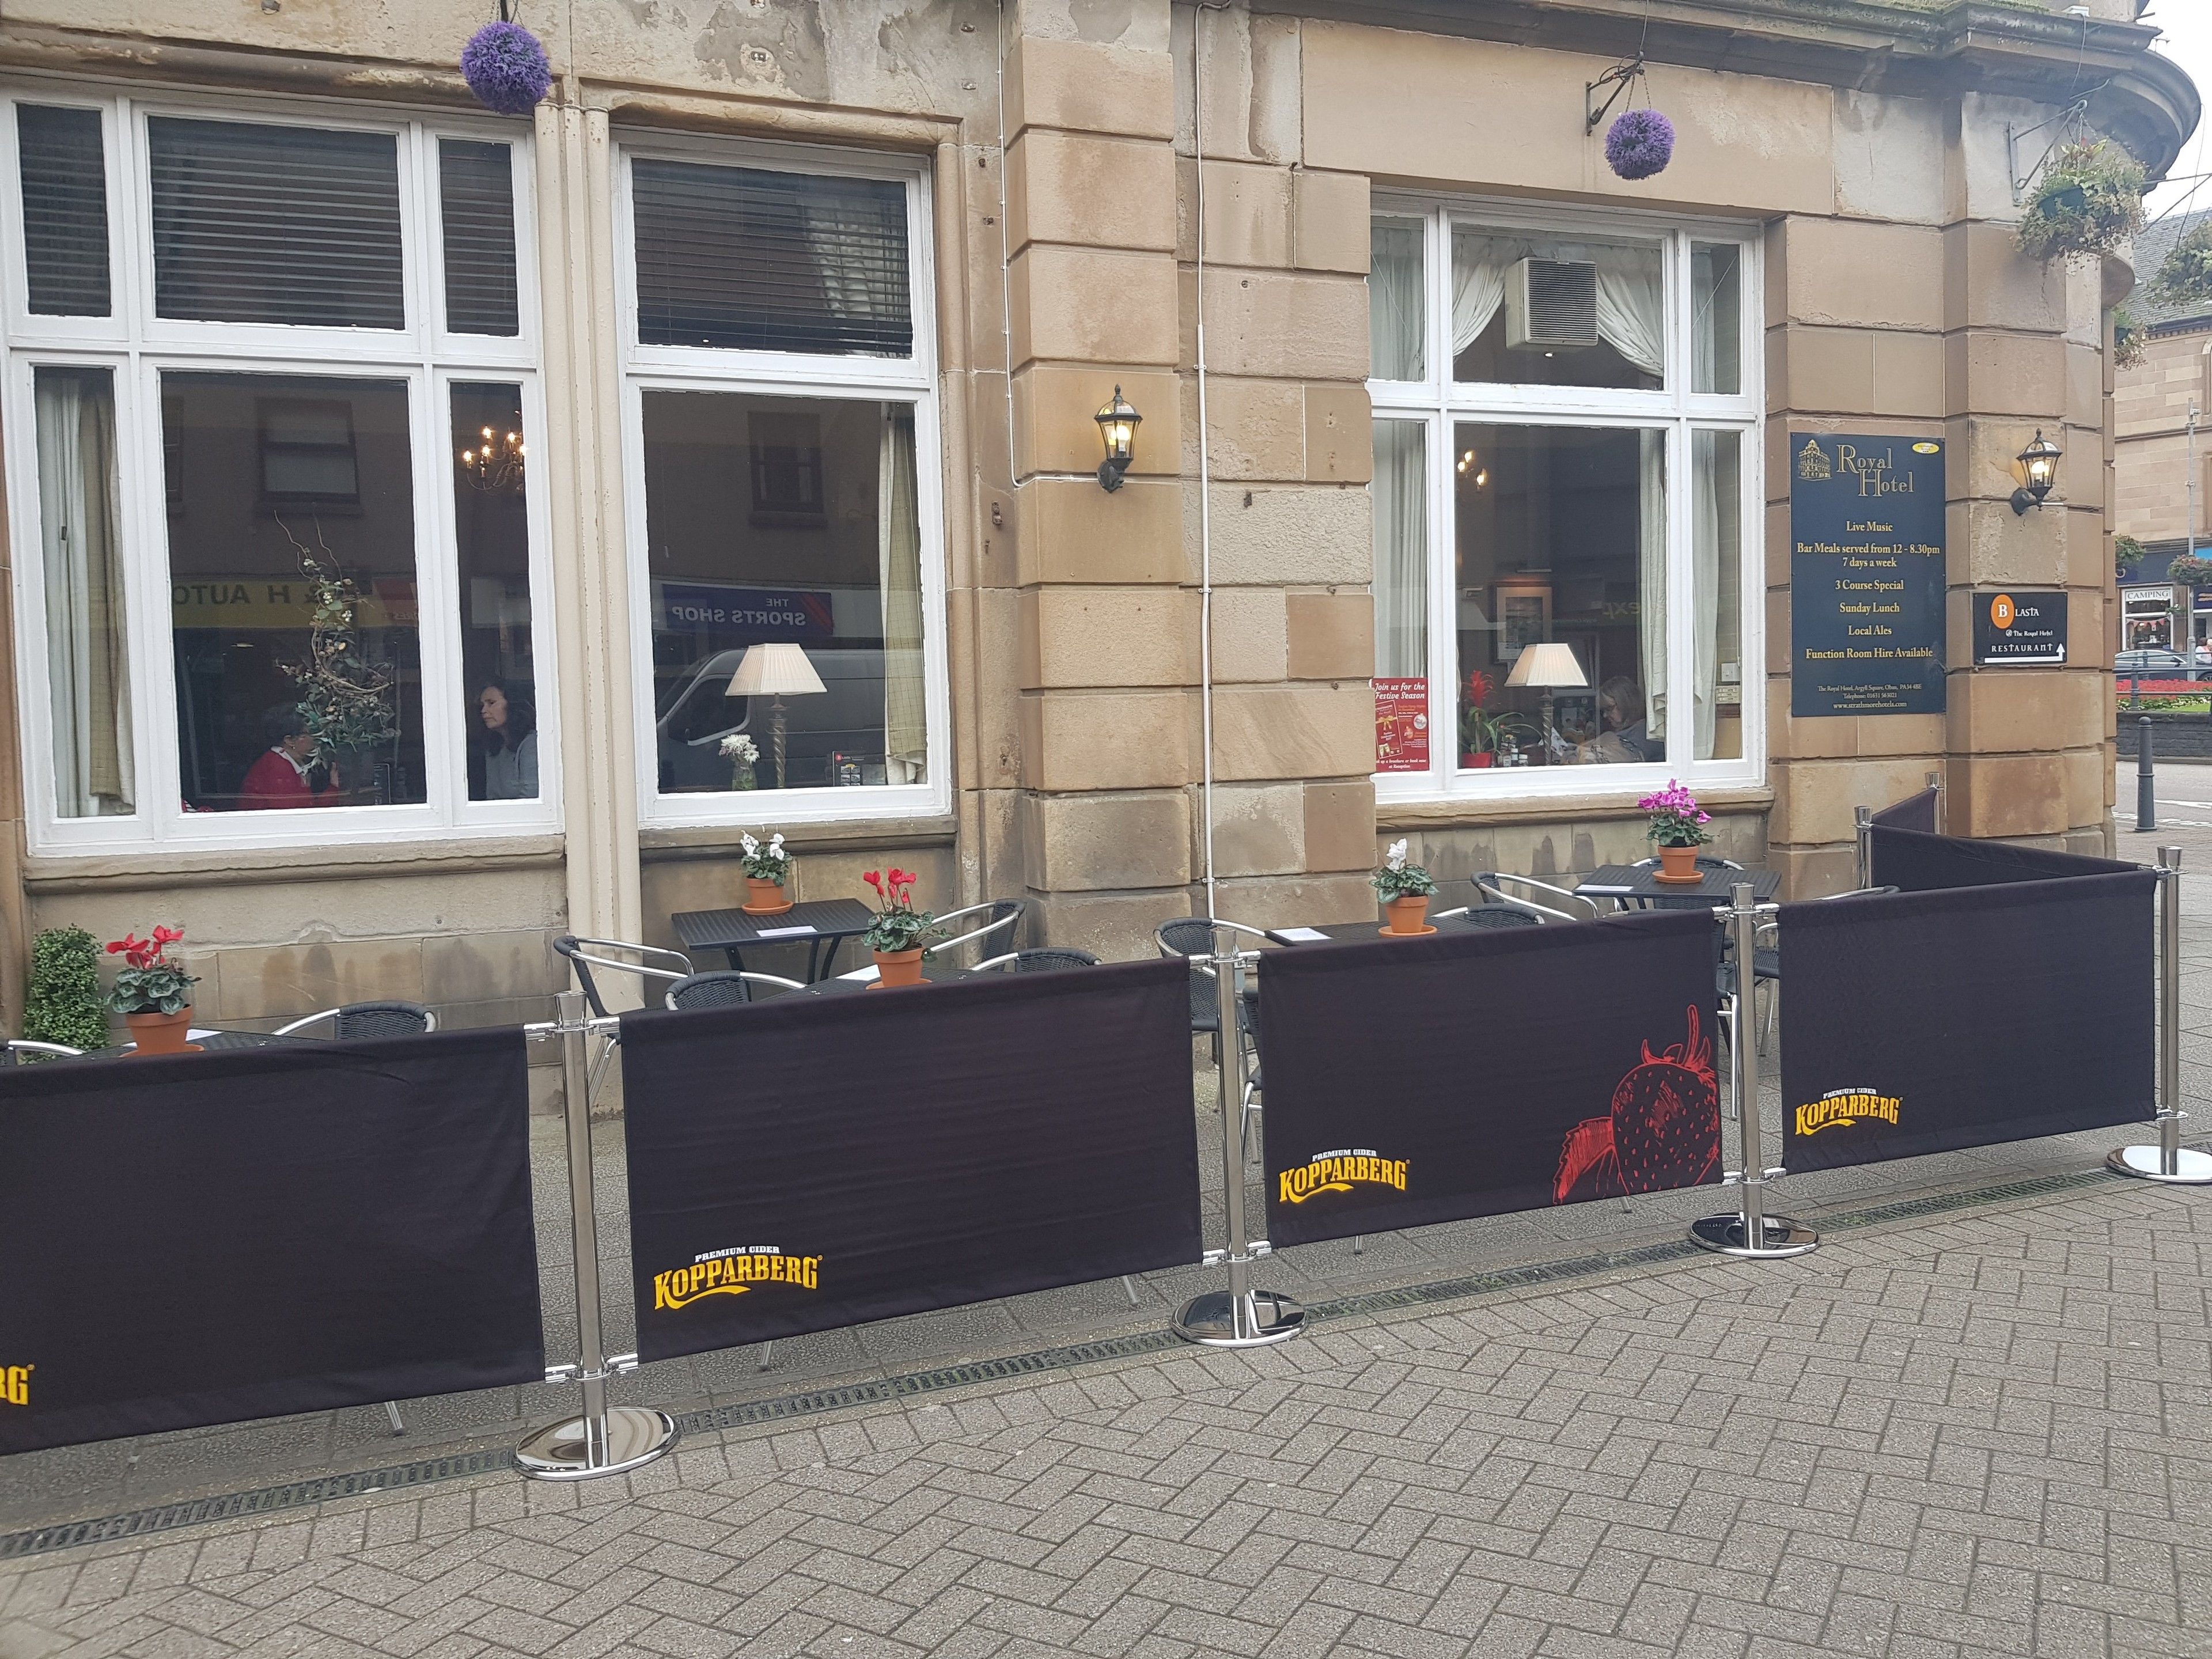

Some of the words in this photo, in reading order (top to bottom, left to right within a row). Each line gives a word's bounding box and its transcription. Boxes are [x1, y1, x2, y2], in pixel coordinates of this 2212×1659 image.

[1836, 444, 1893, 474] Royal
[1858, 468, 1914, 497] Hotel
[1846, 521, 1865, 532] Live
[1867, 521, 1893, 532] Music
[1797, 543, 1813, 553] Bar
[1814, 543, 1840, 553] Meals
[1842, 544, 1869, 554] served
[1870, 544, 1891, 554] from
[1893, 544, 1903, 554] 12
[1910, 544, 1940, 557] 8.30pm
[1842, 557, 1848, 567] 7
[1849, 557, 1868, 570] days
[1876, 558, 1897, 567] week
[1835, 580, 1841, 590] 3
[1842, 579, 1873, 590] Course
[1874, 579, 1904, 593] Special
[2127, 590, 2168, 599] CAMPING
[1839, 602, 1871, 615] Sunday
[1873, 602, 1900, 612] Lunch
[1848, 625, 1872, 635] Local
[1873, 625, 1892, 635] Ales
[1805, 649, 1844, 658] Function
[1846, 648, 1872, 658] Room
[1874, 648, 1893, 658] Hire
[1895, 647, 1934, 657] Available
[1991, 643, 2053, 653] RESTAURANT
[1374, 683, 1388, 692] Join
[1400, 682, 1412, 692] for
[1414, 682, 1425, 690] the
[1823, 1088, 1856, 1099] PREMIUM
[1795, 1094, 1899, 1135] KOPPARBERG
[1312, 1149, 1351, 1162] PREMIUM
[1353, 1149, 1377, 1157] CIDER
[1279, 1157, 1406, 1203] KOPPARBERG
[695, 1246, 746, 1263] PREMIUM
[749, 1245, 780, 1253] CIDER
[653, 1255, 818, 1310] KOPPARBERG
